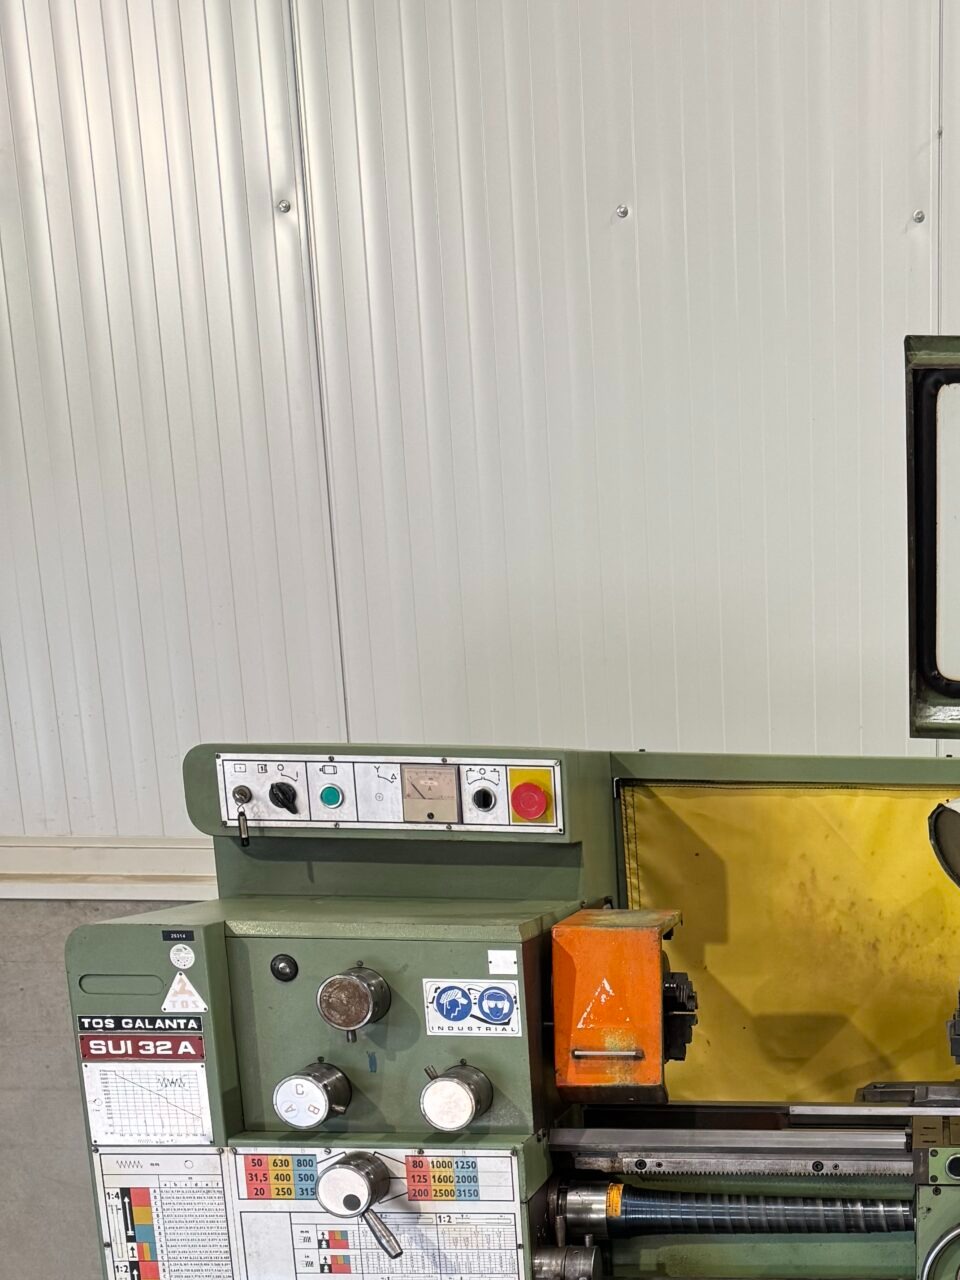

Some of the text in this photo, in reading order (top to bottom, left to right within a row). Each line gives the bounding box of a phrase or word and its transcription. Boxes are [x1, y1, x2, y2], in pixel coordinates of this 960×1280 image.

[81, 1018, 198, 1029] TOS GALANTA
[89, 1040, 196, 1055] SUI 32 A
[295, 1084, 304, 1096] C
[284, 1104, 296, 1113] A
[307, 1104, 320, 1115] B
[251, 1158, 314, 1168] 50 630 800
[412, 1160, 477, 1169] 80 1000 1250
[248, 1173, 315, 1183] 31,5 400 500
[411, 1175, 478, 1184] 125 1600 2000
[106, 1191, 120, 1200] 1:4
[254, 1187, 316, 1196] 20 250 315
[411, 1189, 479, 1198] 200 2500 3150
[438, 1215, 452, 1223] 1:2
[115, 1265, 129, 1273] 1:2
